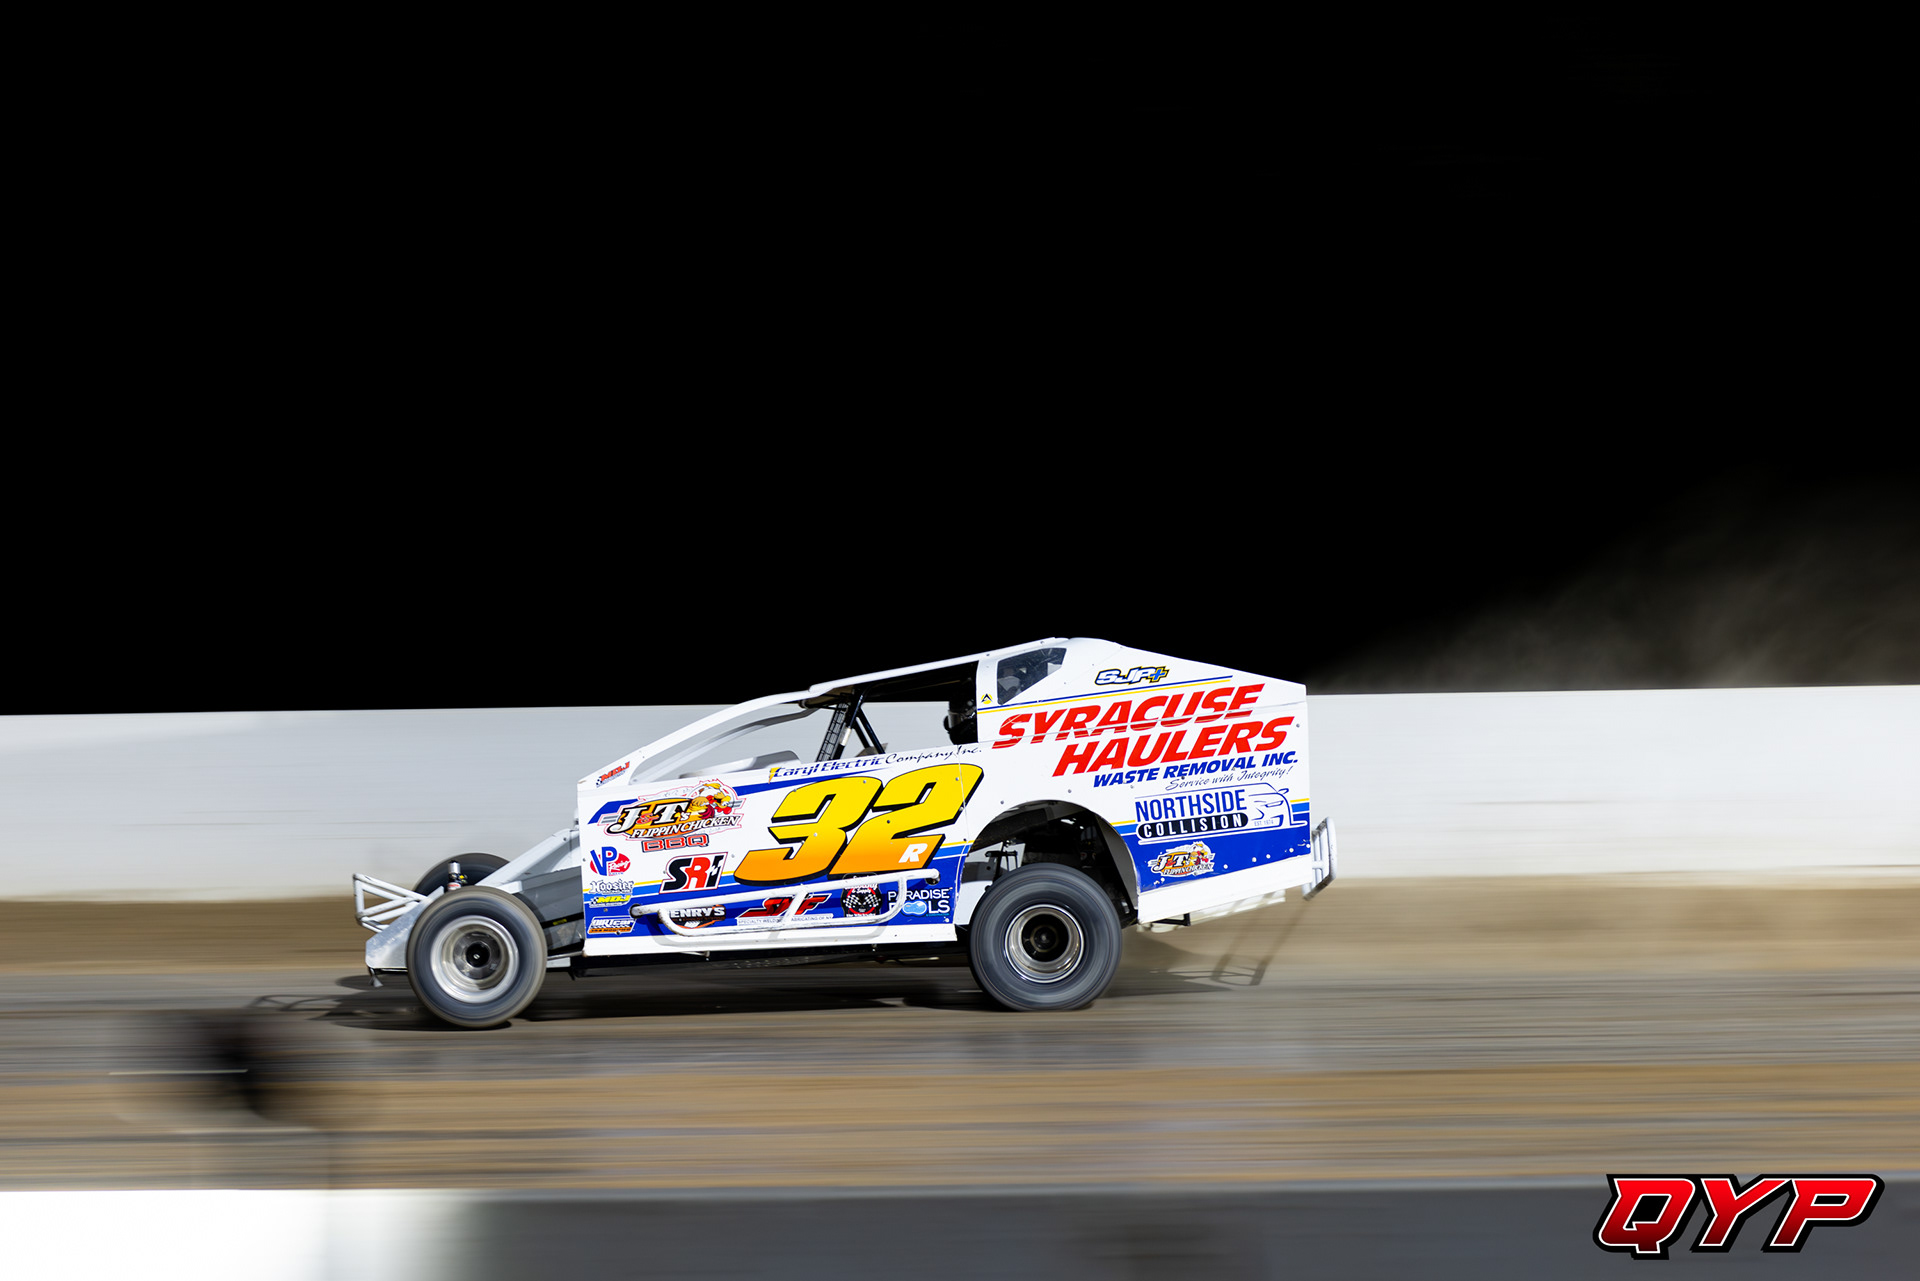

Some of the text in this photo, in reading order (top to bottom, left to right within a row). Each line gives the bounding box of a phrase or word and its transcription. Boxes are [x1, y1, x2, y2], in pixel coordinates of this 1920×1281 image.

[991, 683, 1266, 750] SYRACUSE
[773, 745, 982, 777] Caryl Electric Company Inc.
[1052, 716, 1295, 778] HAULERS
[1093, 751, 1299, 788] WASTE REMOVAL INC.
[1165, 765, 1294, 791] Service with Integrity!
[1135, 789, 1247, 822] NORTHSIDE
[733, 762, 985, 887] 32
[1143, 813, 1243, 838] COLLISION
[642, 834, 709, 852] BBQ
[898, 843, 928, 864] R
[590, 846, 618, 876] VP
[589, 879, 634, 894] Hoosier
[888, 889, 950, 900] PRADISE
[670, 906, 725, 918] ENRY'S
